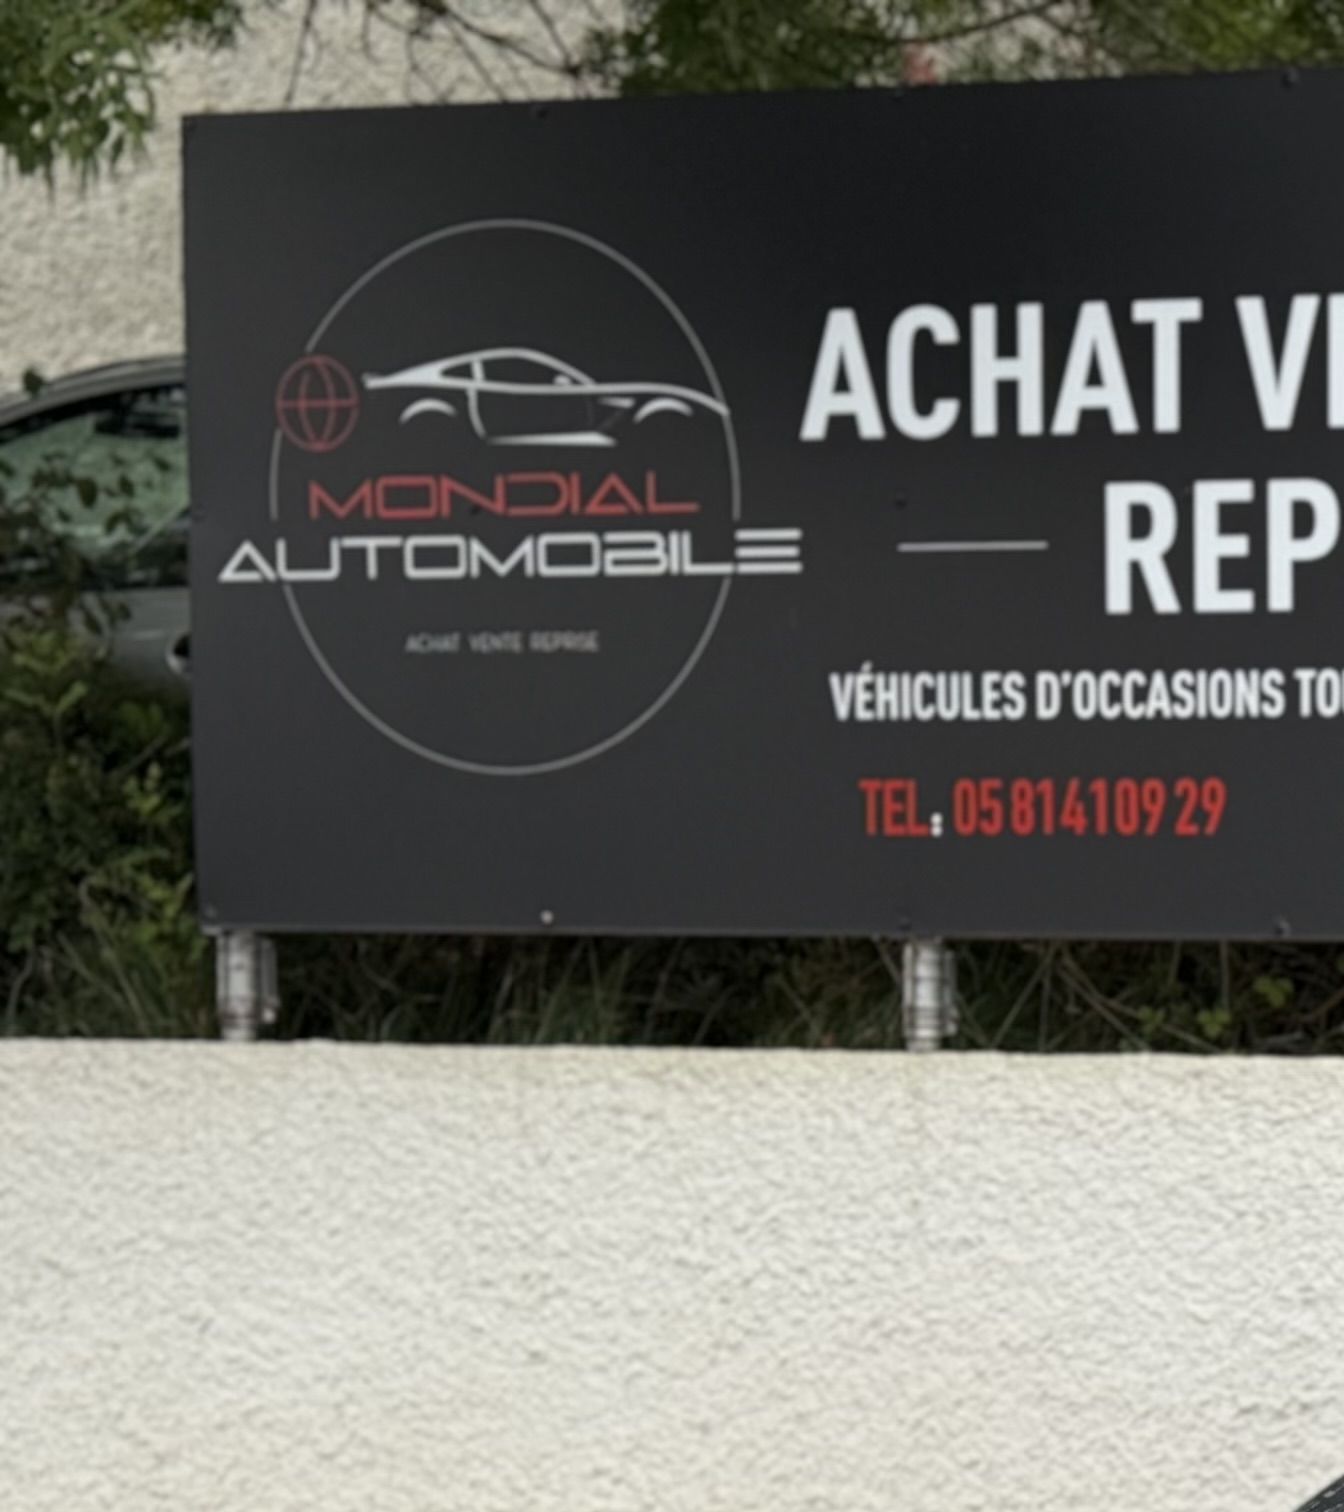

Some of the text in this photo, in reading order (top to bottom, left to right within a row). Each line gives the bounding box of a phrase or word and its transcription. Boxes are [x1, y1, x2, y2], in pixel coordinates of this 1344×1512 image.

[800, 297, 1203, 441] ACHAT
[309, 472, 700, 519] MONDIAL
[217, 527, 803, 583] AUTOMOBILE
[828, 661, 1027, 721] VÉHICULES
[1035, 669, 1286, 720] D'OCCASIONS
